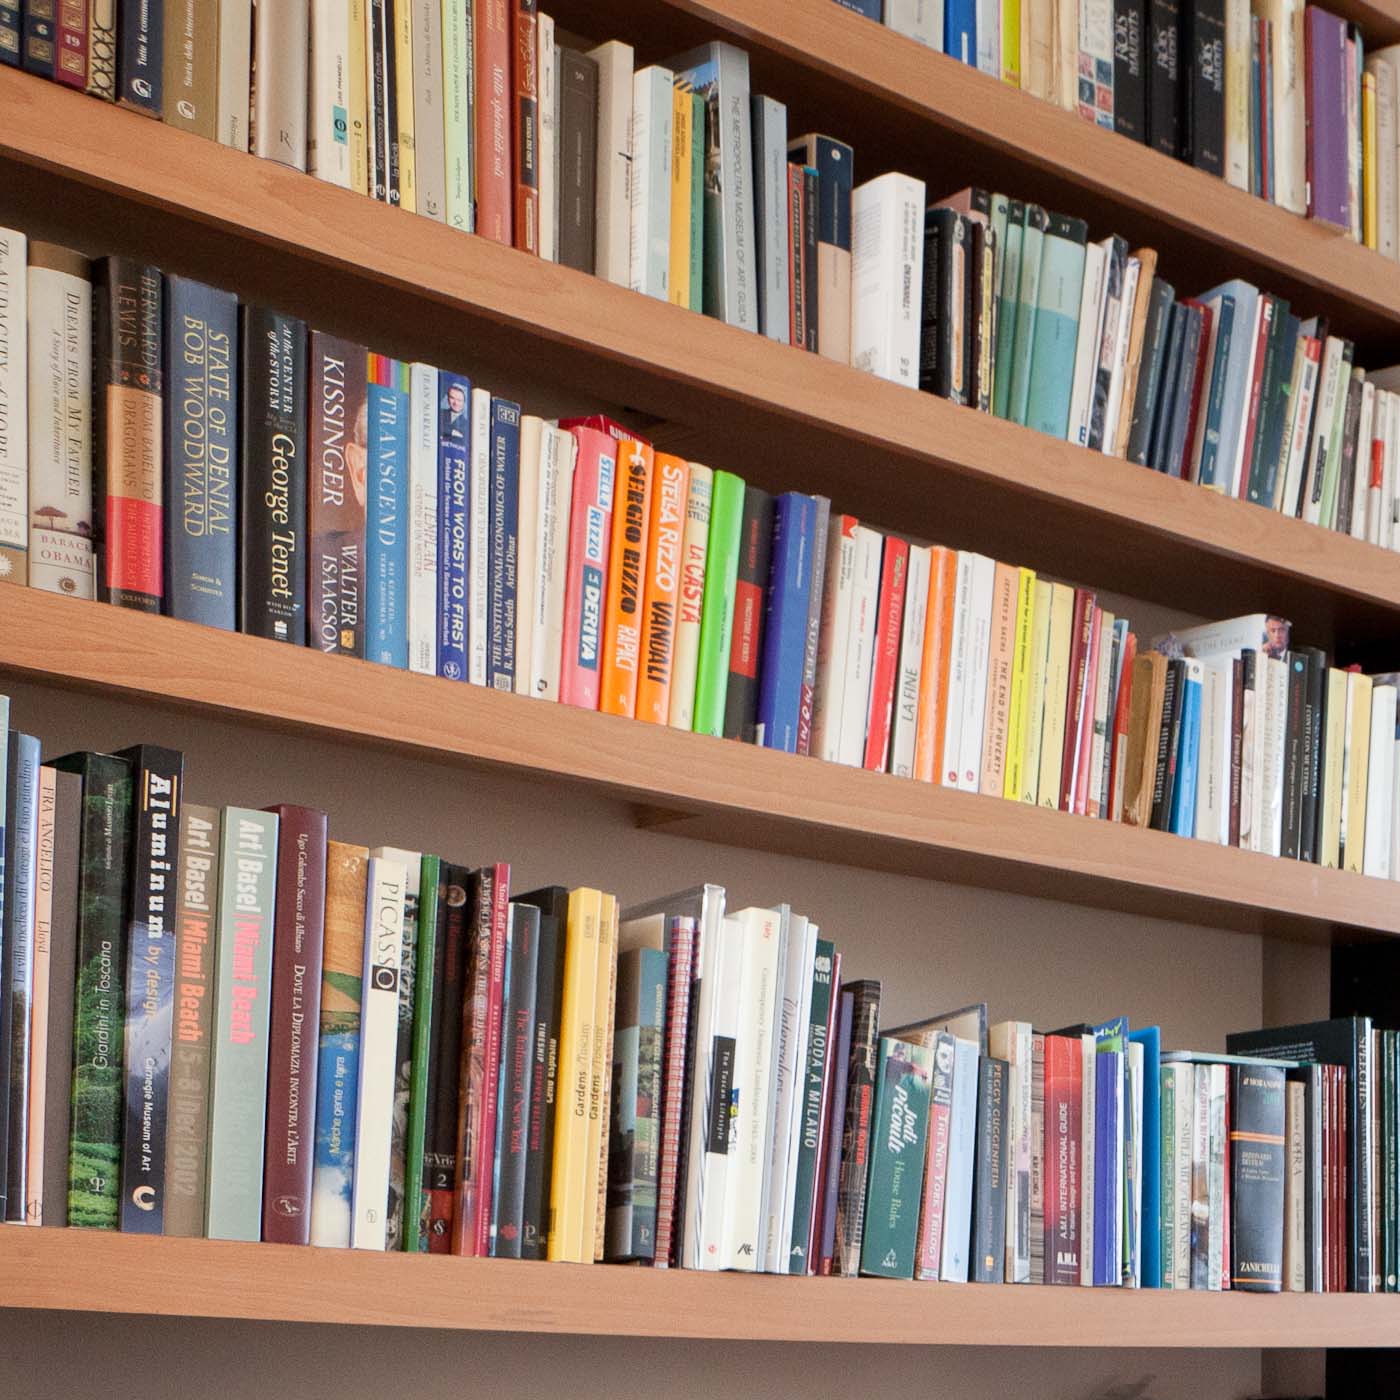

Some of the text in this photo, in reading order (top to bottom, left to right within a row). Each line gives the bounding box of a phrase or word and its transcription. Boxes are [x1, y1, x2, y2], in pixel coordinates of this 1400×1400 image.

[1115, 15, 1128, 61] ROIS
[1200, 39, 1213, 82] ROIS
[119, 284, 137, 349] LEWIS
[141, 275, 159, 370] BERNARD
[66, 292, 83, 497] DREAMS FROM MY FATHER
[269, 359, 281, 410] STORM
[282, 355, 294, 414] CENTER
[122, 400, 137, 488] DRAGOMANS
[183, 315, 205, 537] BOB WOODWARD
[208, 328, 230, 536] STATE OF DENIAL
[322, 355, 345, 507] KISSINGER
[378, 396, 397, 546] TRANSCEND
[587, 457, 612, 558] STELLA RIZZO
[624, 464, 647, 543] SERGIO
[40, 534, 92, 553] BARACK
[265, 433, 296, 599] George Tenet
[492, 436, 506, 667] THE INSTITUTIONAL ECONOMICS OF WATER
[505, 534, 516, 562] Dinar
[656, 465, 683, 593] STELLA RIZZO
[40, 550, 92, 570] OBAMA
[341, 544, 358, 626] WALTER
[451, 458, 466, 653] FROM WORST TO FIRST
[504, 562, 515, 589] Ariel
[620, 548, 641, 615] RIZZO
[681, 543, 704, 624] LA CASTA
[320, 554, 338, 654] ISAACSON
[504, 599, 514, 629] Saleth
[581, 586, 600, 660] DERIVA
[504, 631, 514, 656] Maria
[647, 601, 673, 685] VANDALI
[902, 667, 919, 722] LA FINE
[994, 661, 1008, 775] THE END OF POVERTY
[39, 785, 55, 892] FRA ANGELICO
[148, 773, 174, 939] Aluminum
[295, 832, 308, 850] Ugo
[296, 851, 307, 888] Colombo
[295, 912, 305, 923] di
[296, 888, 306, 912] Sacco
[375, 881, 400, 989] PICASSO
[146, 945, 161, 963] by
[181, 918, 208, 980] Miami
[294, 923, 305, 954] Albiano
[93, 940, 112, 1070] Giardini in Toscana
[179, 982, 206, 1041] Beach
[141, 1057, 156, 1171] Carnegie Museum of Art
[575, 1071, 587, 1117] Gardens
[588, 1074, 601, 1120] Gardens
[718, 1051, 730, 1140] The Tuscan Lifestyle
[804, 1024, 827, 1149] MODA A MILANO
[888, 1084, 909, 1155] Picoult
[901, 1102, 919, 1145] Jodi
[1059, 1103, 1068, 1134] GUIDE
[991, 1064, 1003, 1189] PEGGY GUGGENHEIM
[888, 1160, 906, 1229] House Rules
[928, 1114, 948, 1263] THE NEW YORK TRILOGY
[1059, 1135, 1068, 1211] INTERNATIONAL
